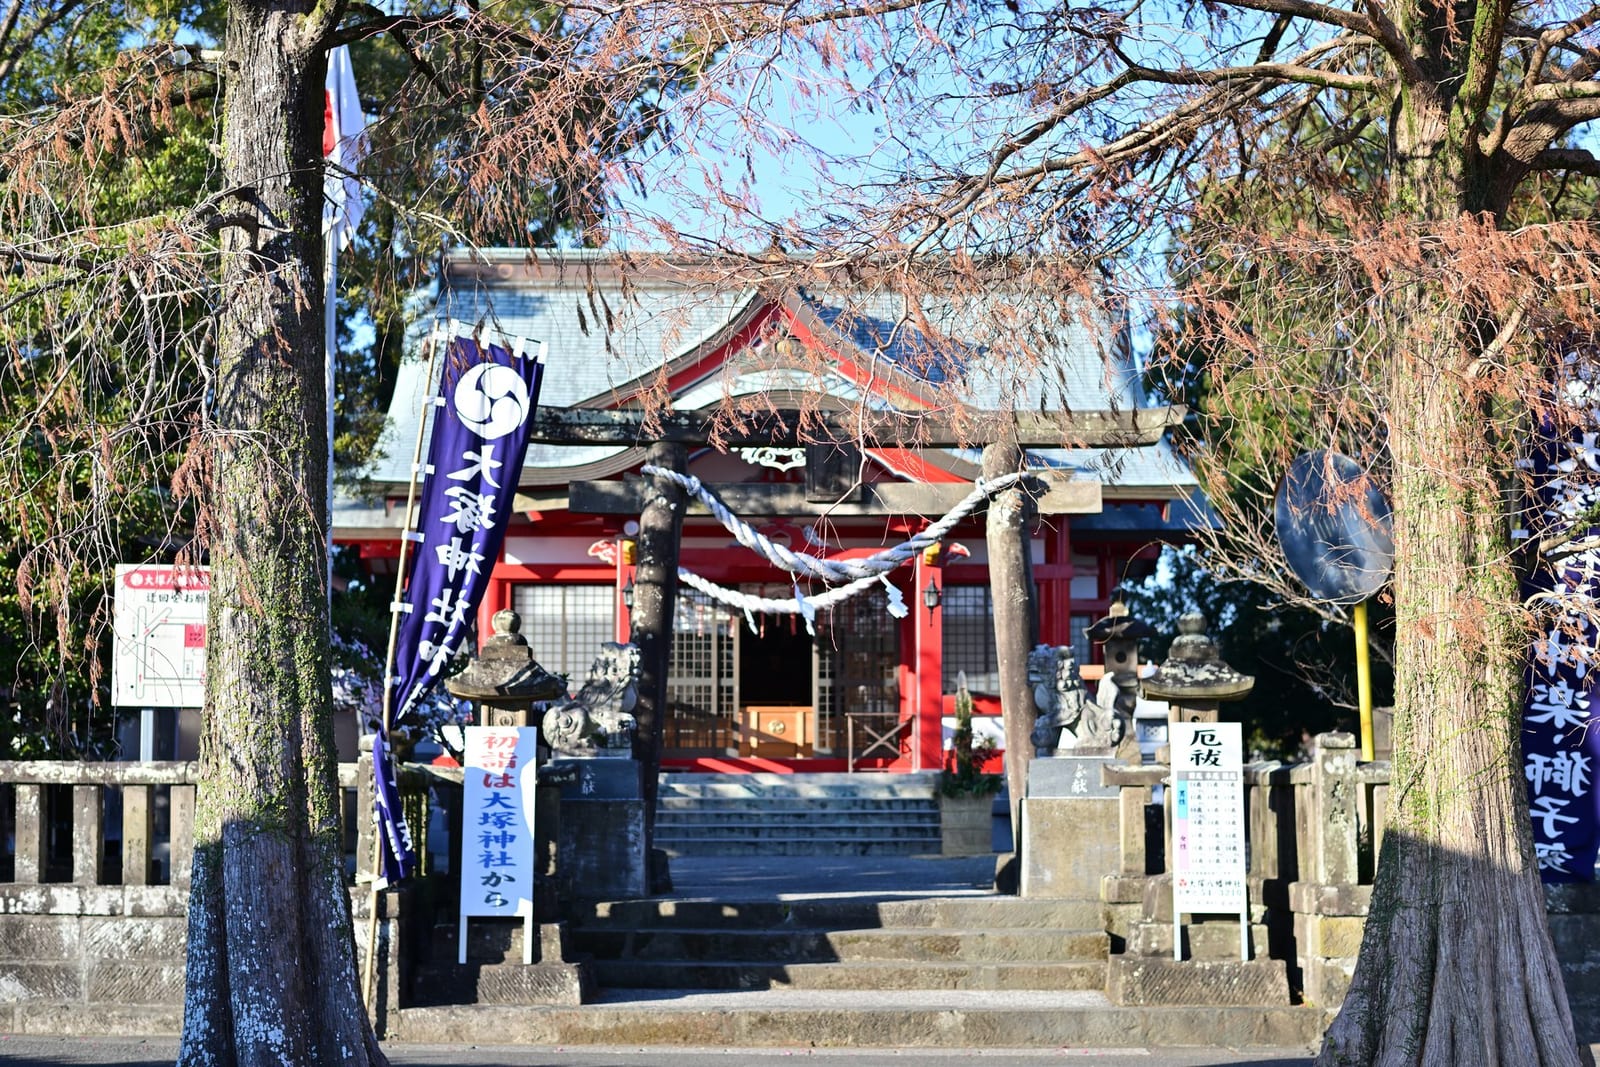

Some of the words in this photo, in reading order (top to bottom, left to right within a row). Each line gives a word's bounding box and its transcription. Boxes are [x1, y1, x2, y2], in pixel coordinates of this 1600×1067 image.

[1190, 729, 1223, 767] 厄祓
[477, 731, 519, 908] 初詣は大塚神社から
